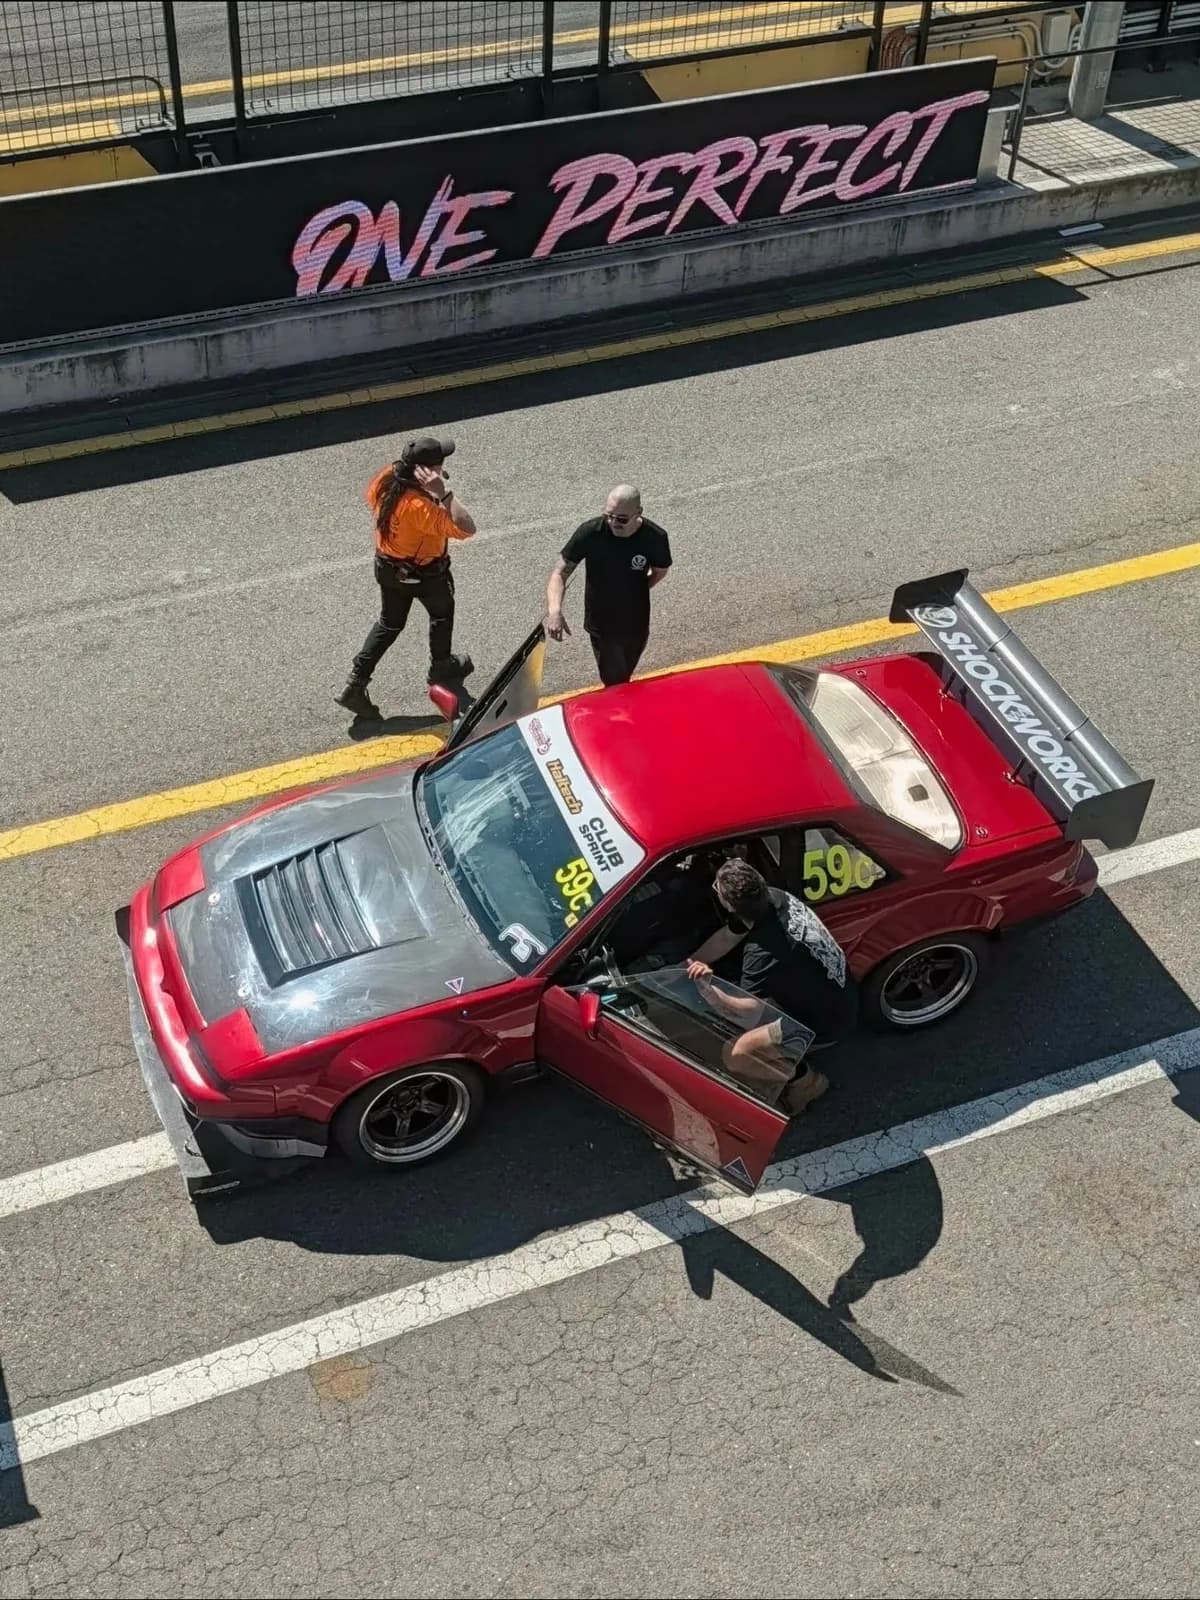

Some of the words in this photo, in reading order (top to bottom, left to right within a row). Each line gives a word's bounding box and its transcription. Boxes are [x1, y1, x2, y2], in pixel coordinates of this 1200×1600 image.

[292, 175, 514, 296] ONE
[532, 89, 990, 258] PERFECT
[546, 759, 583, 815] Haltech
[578, 823, 611, 873] SPRINT
[588, 816, 624, 868] CLUB
